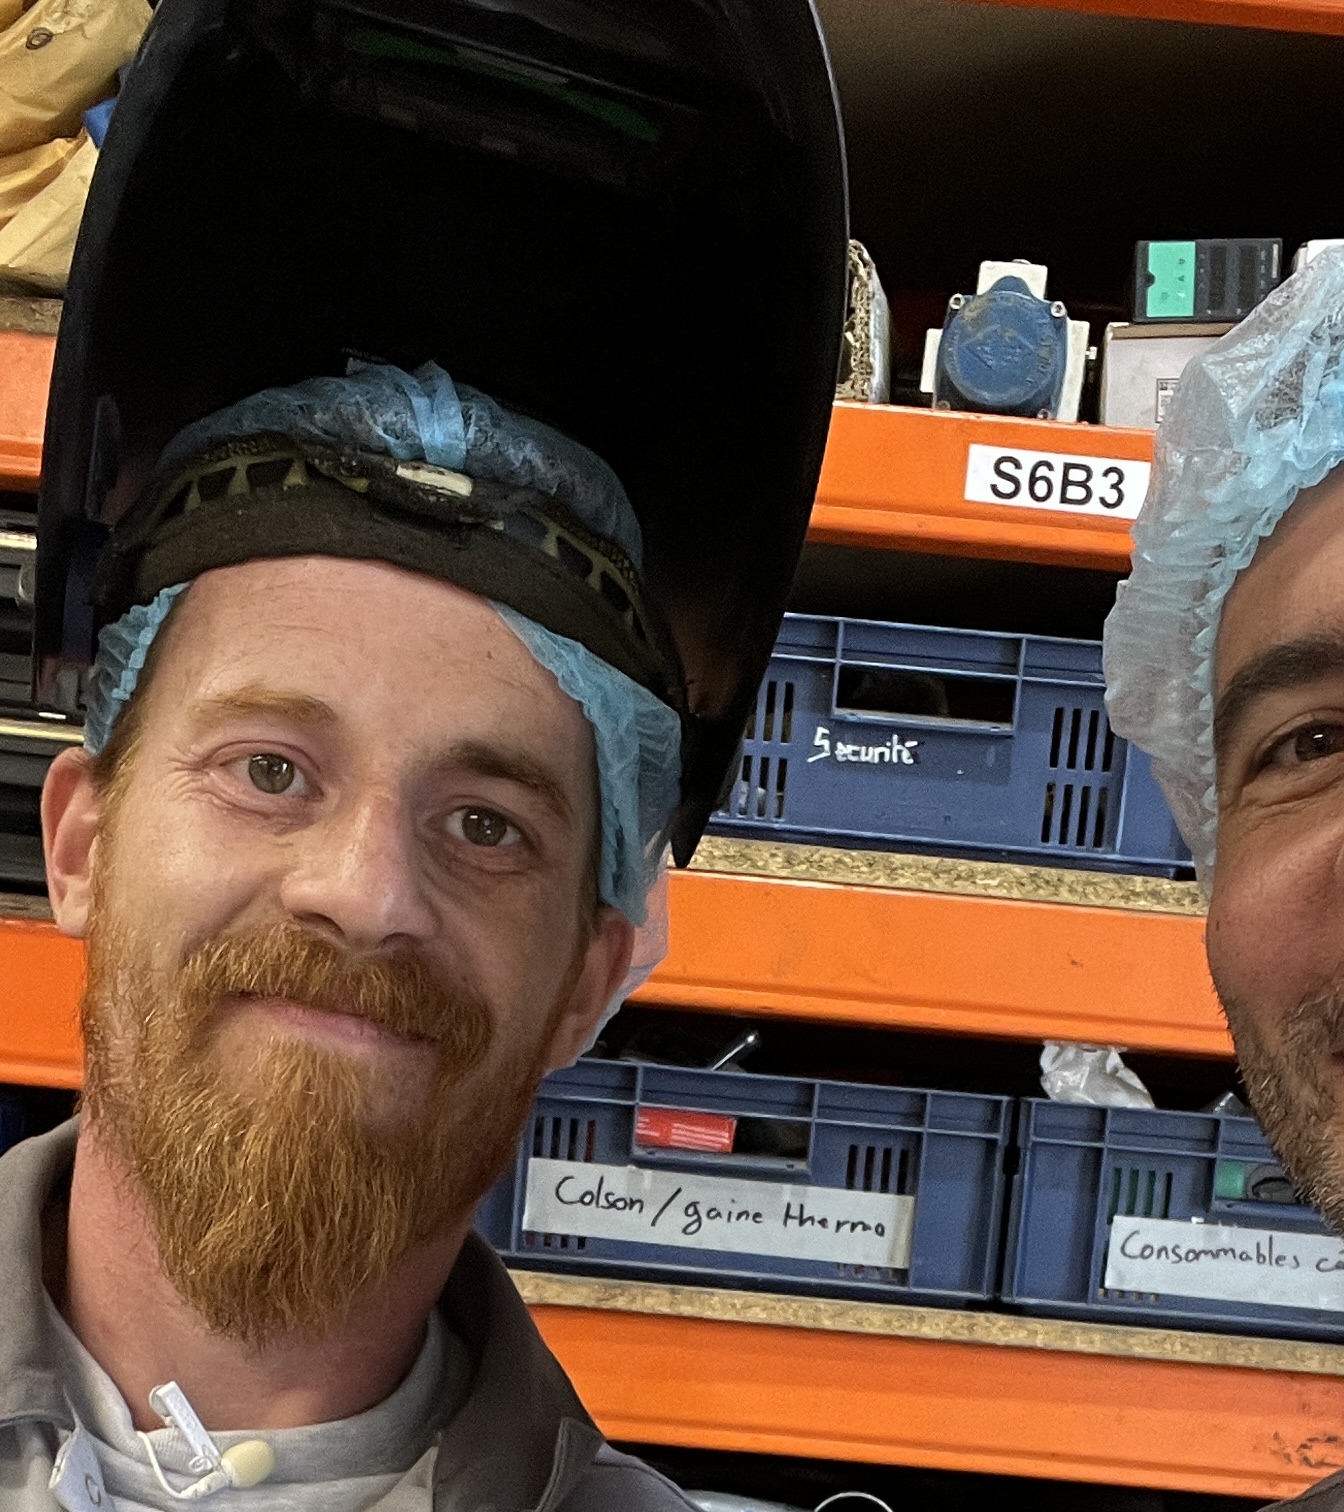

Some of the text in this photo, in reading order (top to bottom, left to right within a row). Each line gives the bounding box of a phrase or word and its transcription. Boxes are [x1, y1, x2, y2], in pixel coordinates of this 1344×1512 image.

[989, 456, 1125, 509] S6B3
[553, 1175, 646, 1217] Colson
[682, 1196, 764, 1236] gaine
[783, 1203, 887, 1238] thermo
[1120, 1230, 1301, 1271] Consommables
